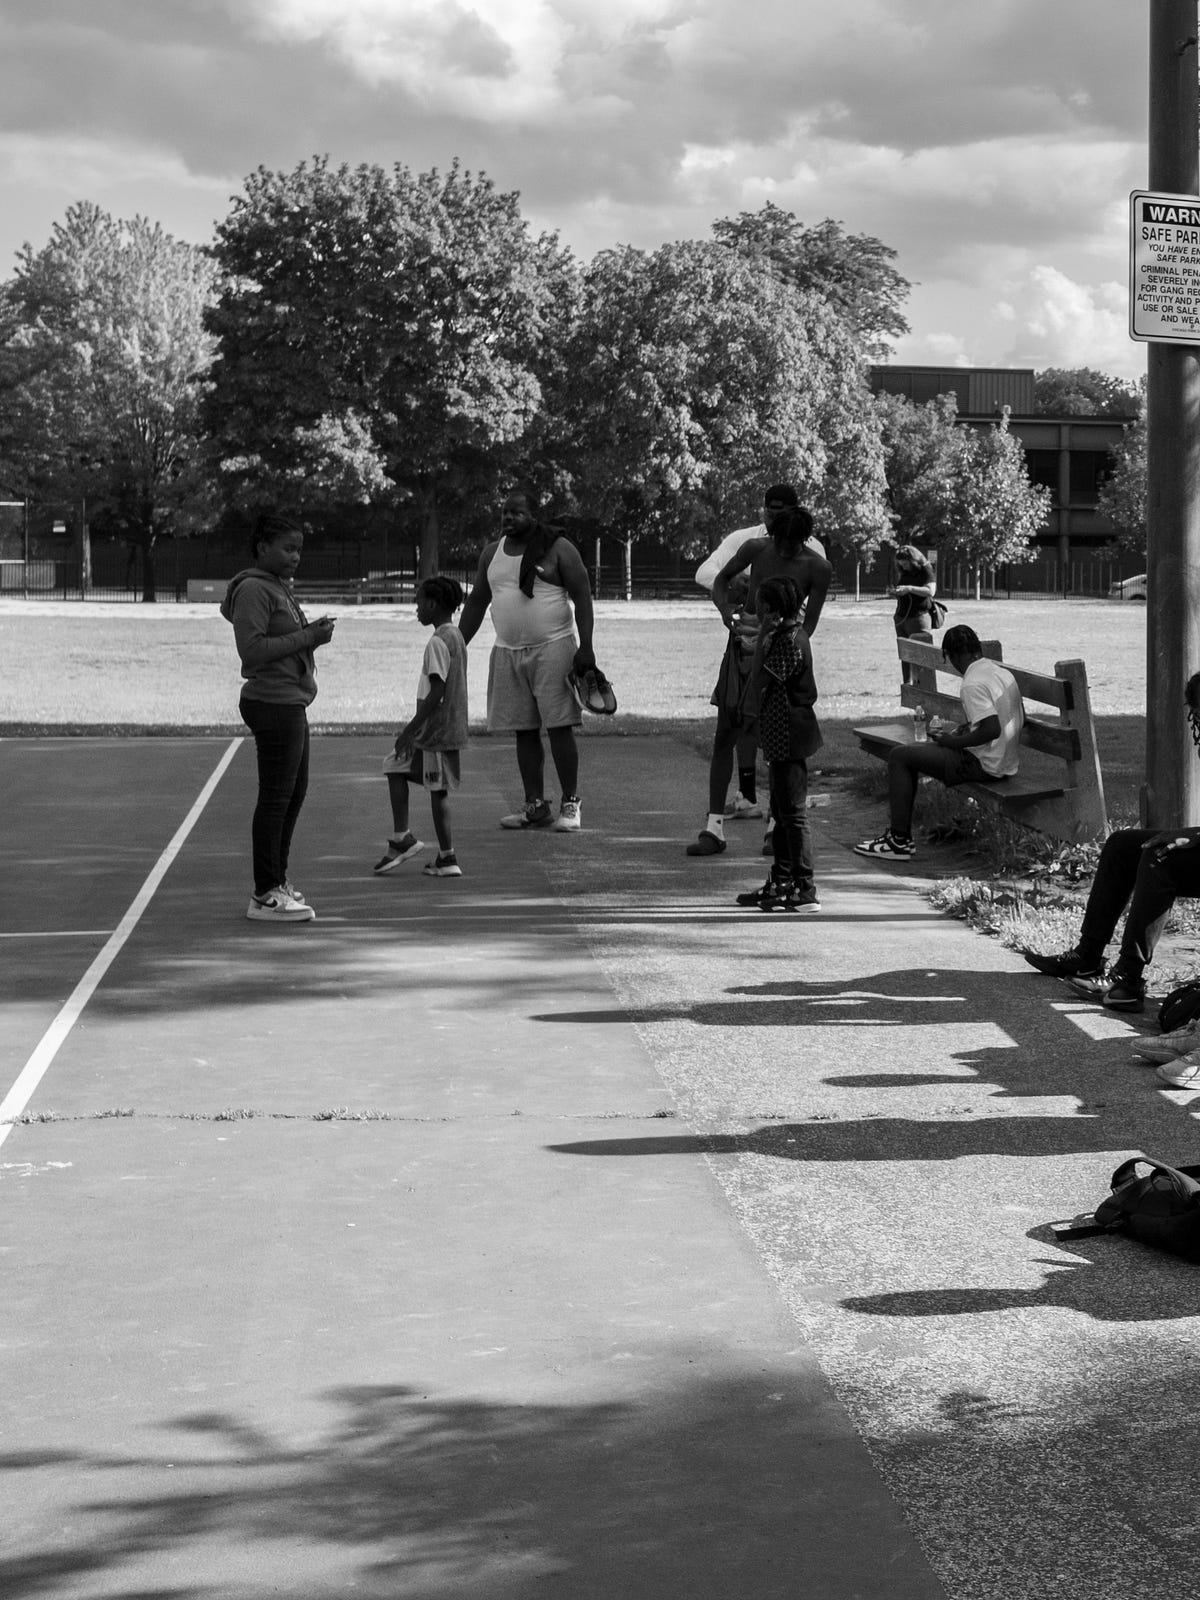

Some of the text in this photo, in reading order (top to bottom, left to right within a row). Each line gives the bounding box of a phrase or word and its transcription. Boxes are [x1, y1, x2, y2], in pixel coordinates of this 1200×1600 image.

[1142, 226, 1171, 242] SAFE
[1149, 243, 1165, 252] YOU
[1168, 245, 1188, 254] HAVE
[1157, 254, 1177, 263] SAFE
[1180, 256, 1200, 265] PARK
[1141, 265, 1179, 275] CRIMINAL
[1148, 275, 1188, 285] SEVERELY
[1141, 284, 1157, 292] FOR
[1160, 286, 1184, 295] GANG
[1137, 294, 1173, 303] ACTIVITY
[1175, 297, 1192, 305] AND
[1143, 304, 1159, 312] USE
[1161, 305, 1174, 313] OR
[1176, 307, 1198, 315] SALE
[1160, 315, 1178, 323] AND
